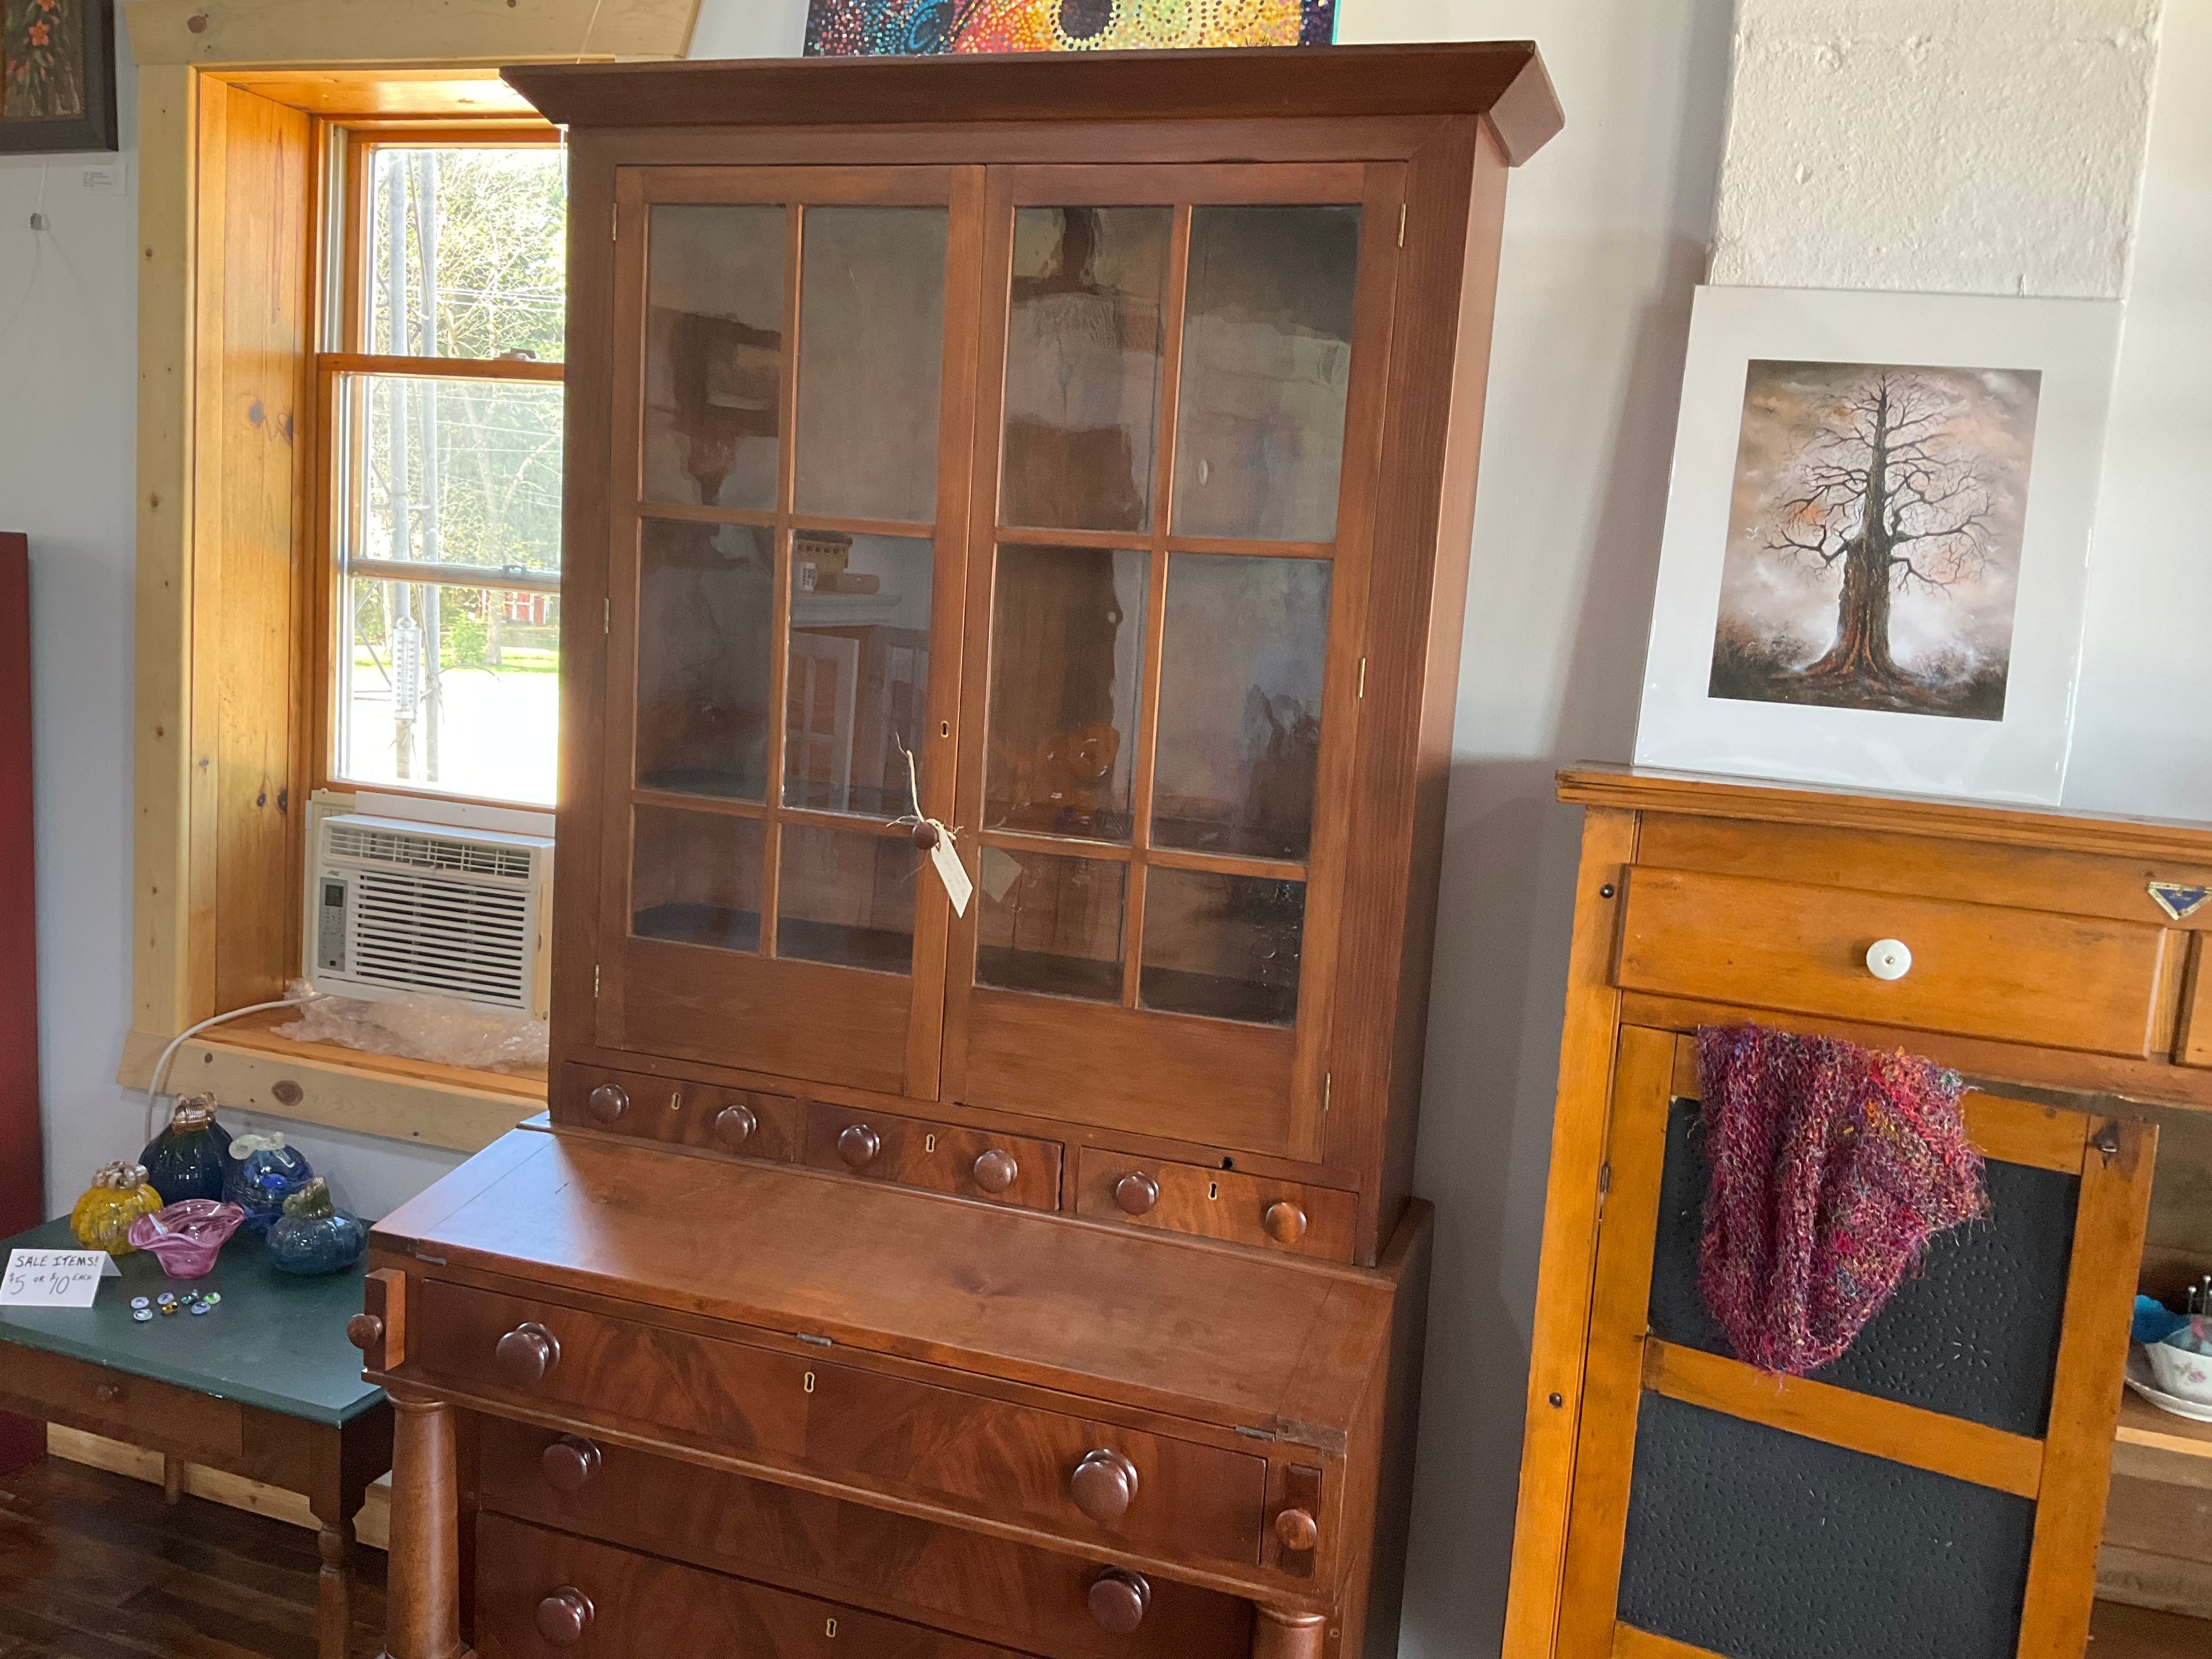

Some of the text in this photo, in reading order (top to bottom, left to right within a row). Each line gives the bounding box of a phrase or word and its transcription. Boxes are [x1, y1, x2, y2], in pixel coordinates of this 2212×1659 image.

[15, 1255, 99, 1267] SALE ITEMS!
[9, 1273, 26, 1295] $5
[49, 1273, 70, 1295] $10
